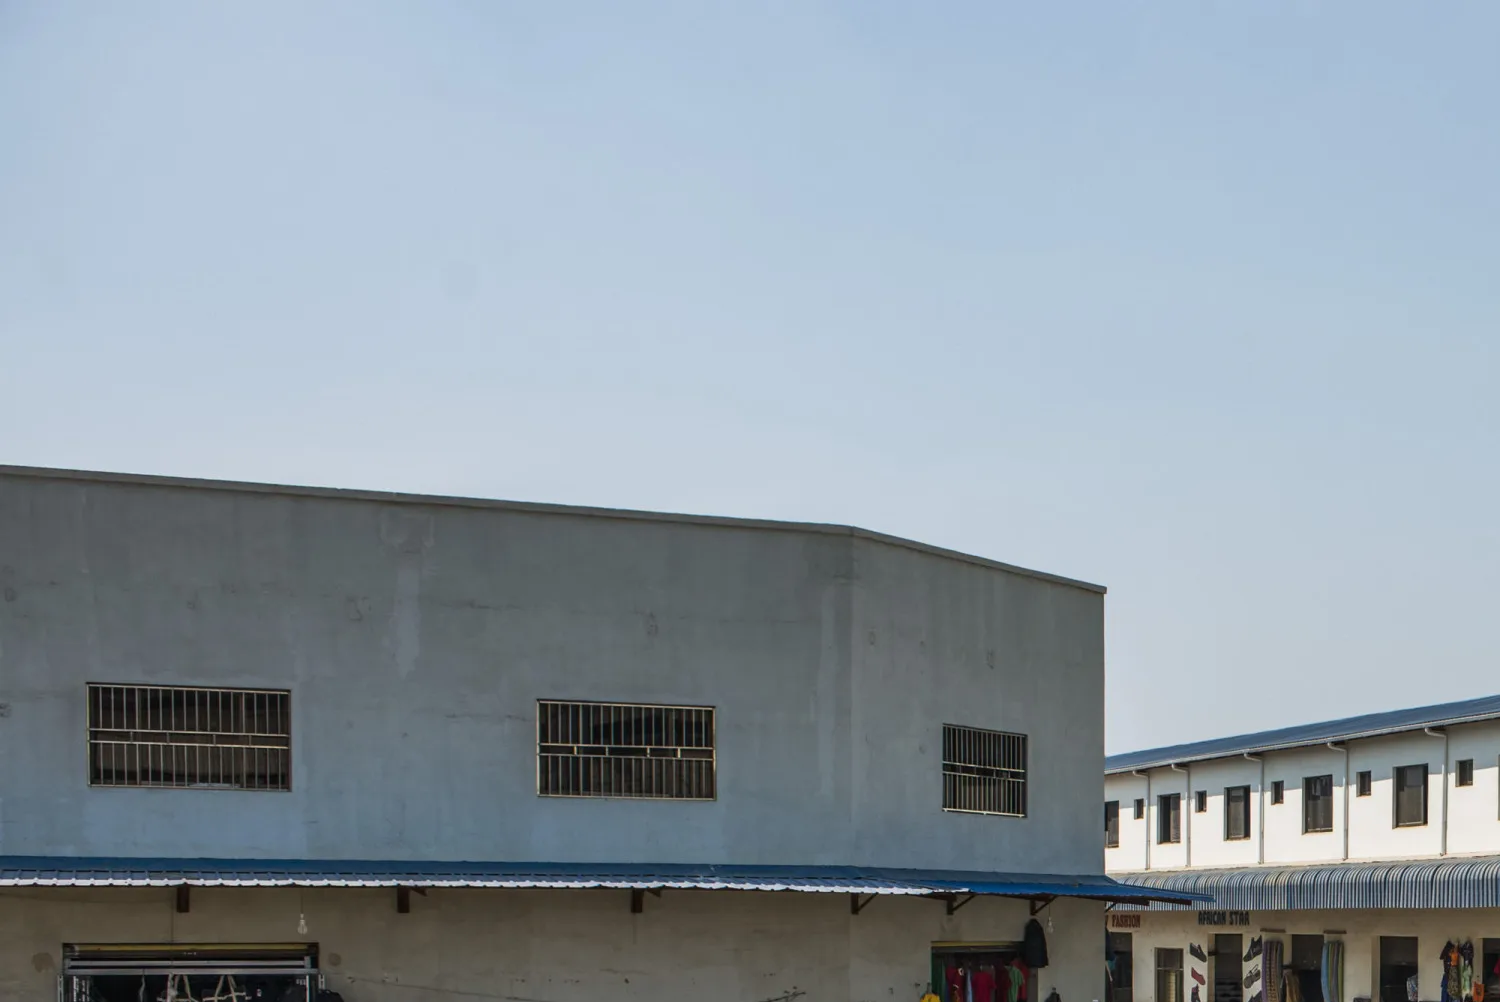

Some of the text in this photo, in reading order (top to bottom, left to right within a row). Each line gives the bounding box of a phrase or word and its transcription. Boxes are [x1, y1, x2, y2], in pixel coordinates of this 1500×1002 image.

[1111, 914, 1141, 928] FASHION
[1198, 910, 1250, 926] AFRICAN STAR
